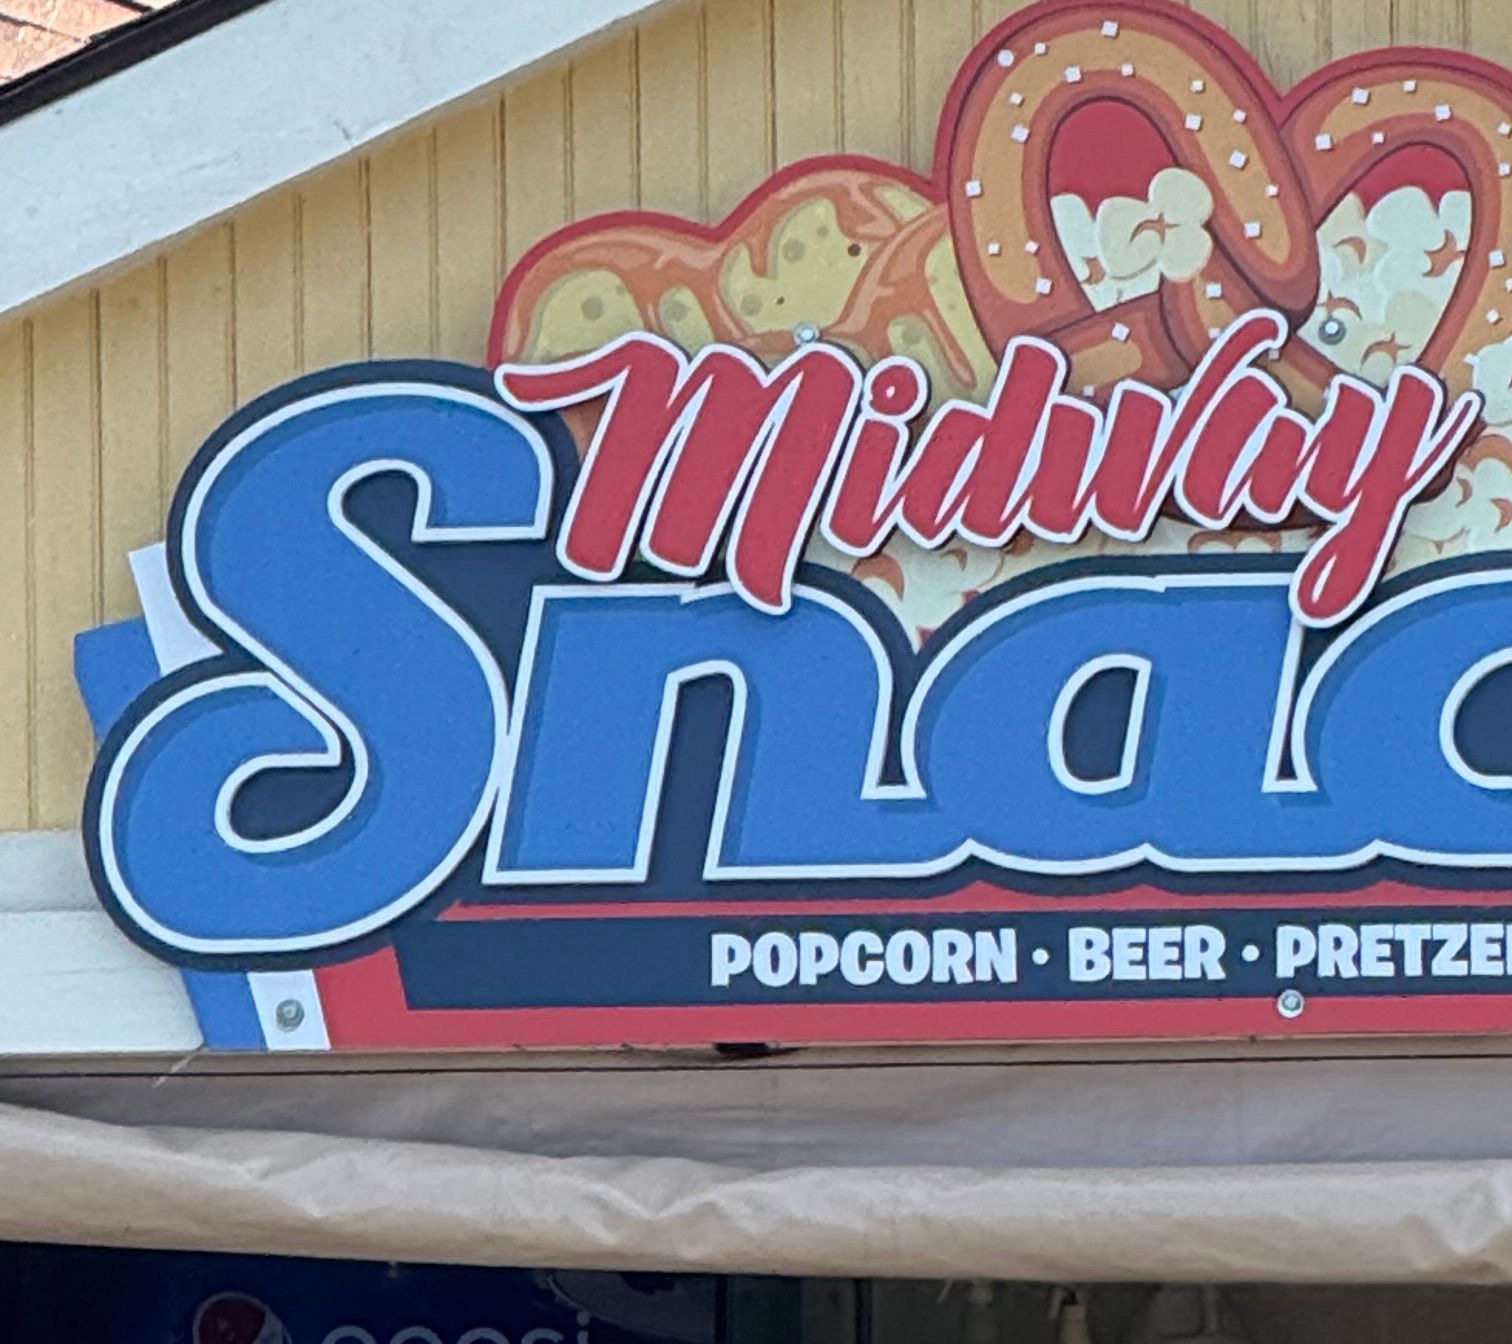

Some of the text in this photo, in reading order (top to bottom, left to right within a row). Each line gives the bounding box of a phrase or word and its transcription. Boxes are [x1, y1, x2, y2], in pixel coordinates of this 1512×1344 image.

[495, 311, 1480, 629] Midway
[711, 927, 1017, 986] POPCORN
[1068, 925, 1226, 982] BEER
